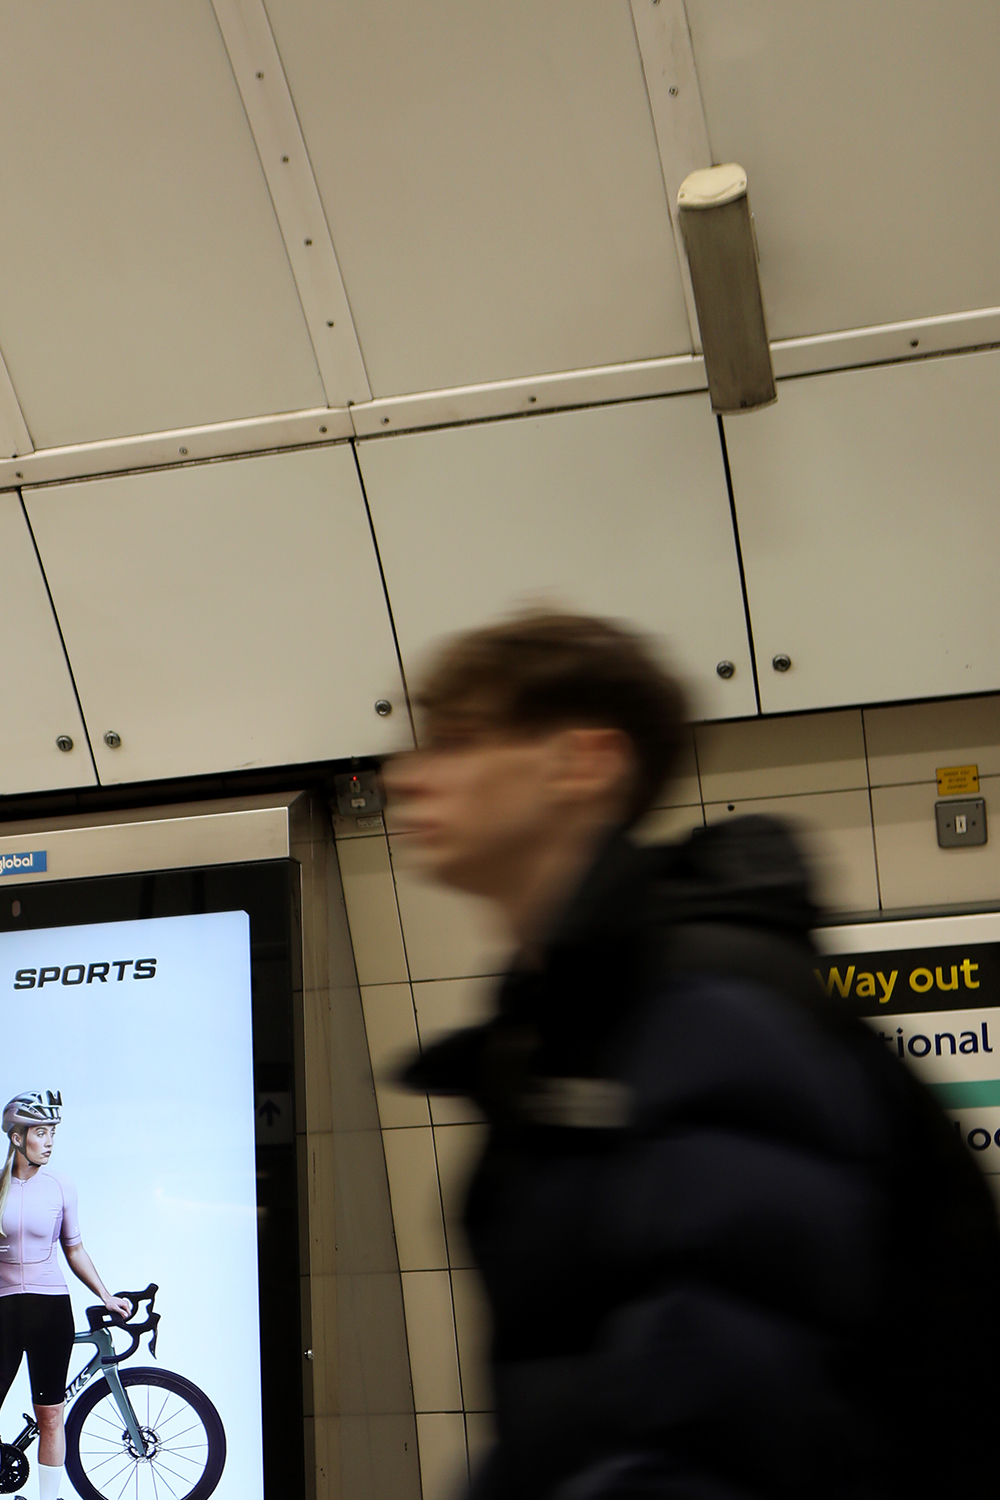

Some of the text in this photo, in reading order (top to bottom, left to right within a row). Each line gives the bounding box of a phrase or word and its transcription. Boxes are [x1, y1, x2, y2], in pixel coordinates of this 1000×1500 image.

[13, 957, 157, 991] SPORTS
[813, 958, 980, 1004] Way out
